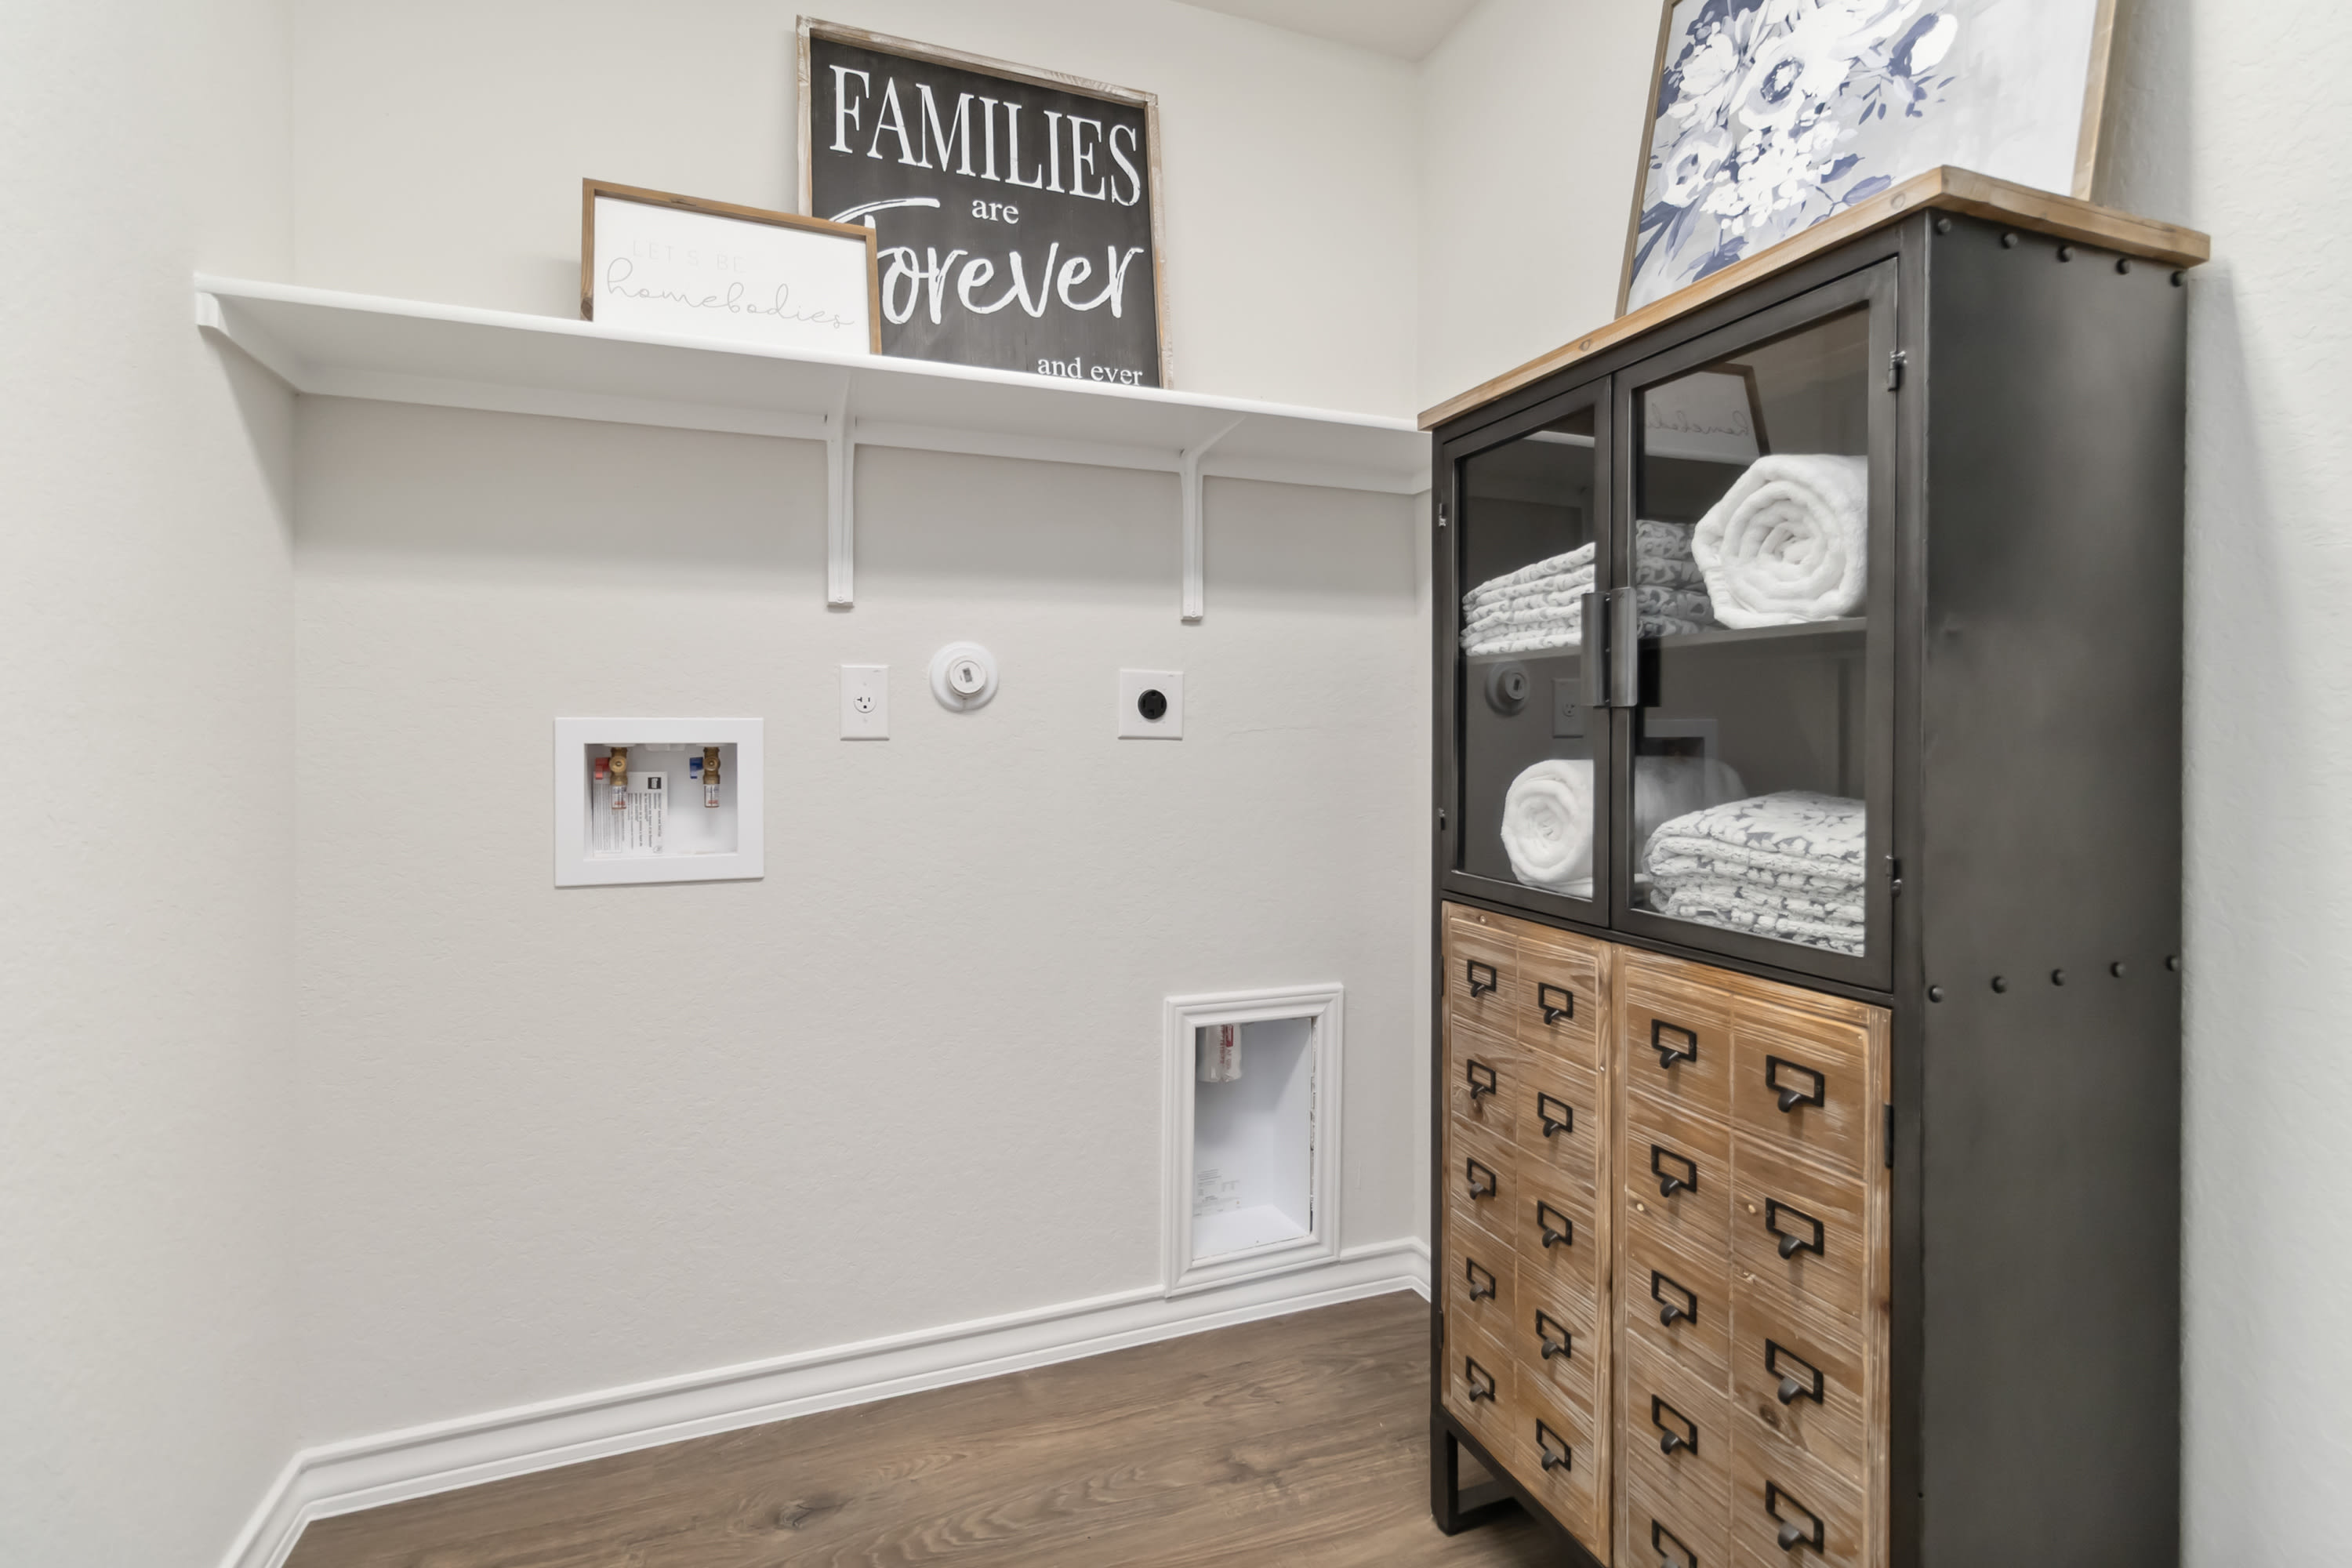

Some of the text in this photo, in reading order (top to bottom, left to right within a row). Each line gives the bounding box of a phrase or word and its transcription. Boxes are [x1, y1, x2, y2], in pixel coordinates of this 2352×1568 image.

[829, 64, 1141, 207] FAMILIES
[971, 199, 1019, 224] are
[632, 239, 747, 274] LETS BE
[607, 257, 855, 328] homebodies
[1037, 358, 1143, 386] and ever
